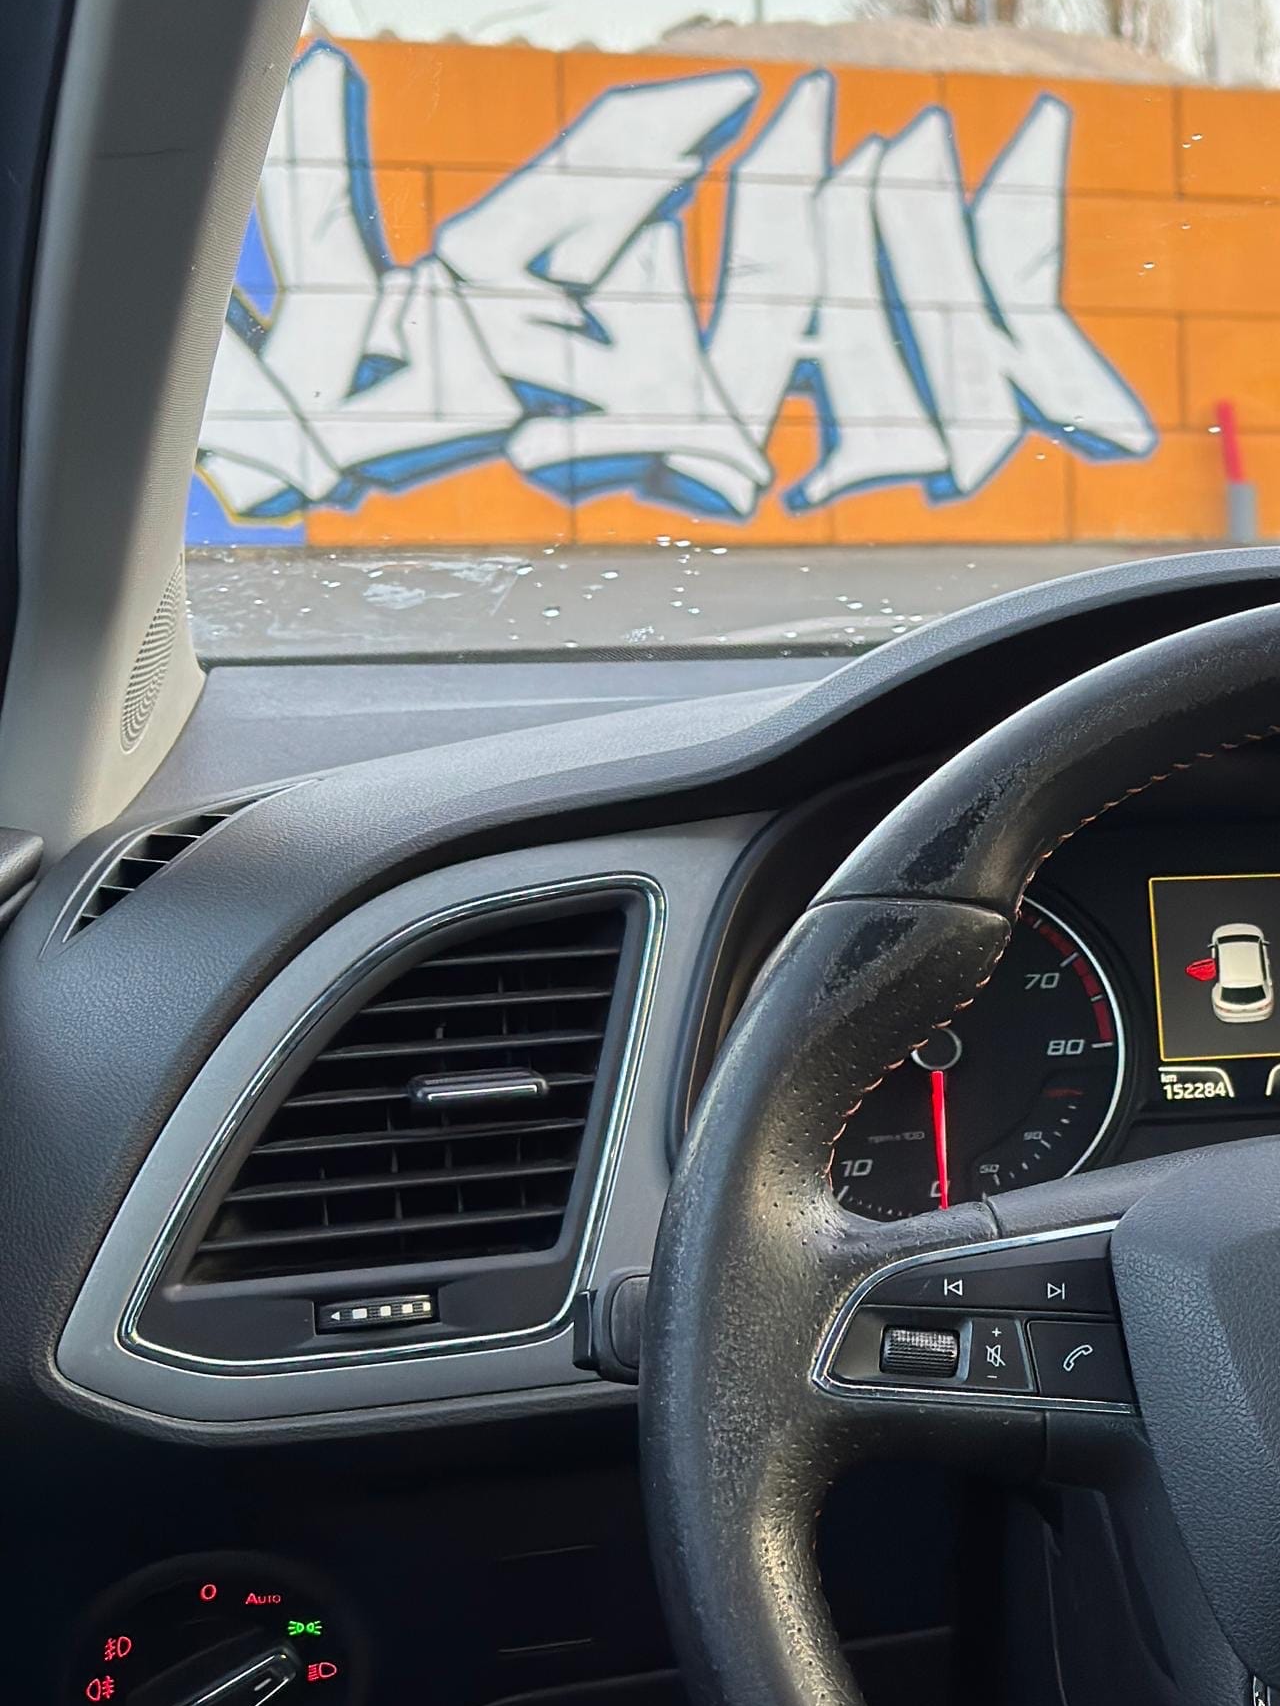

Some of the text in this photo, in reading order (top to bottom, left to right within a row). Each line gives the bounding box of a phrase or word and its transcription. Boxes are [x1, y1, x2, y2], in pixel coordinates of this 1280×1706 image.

[1024, 972, 1060, 990] 70
[1047, 1039, 1085, 1056] 80
[1160, 1073, 1177, 1083] km
[1163, 1082, 1226, 1100] 152284
[1024, 1131, 1042, 1140] 90
[840, 1159, 872, 1177] 10
[980, 1164, 999, 1173] 50
